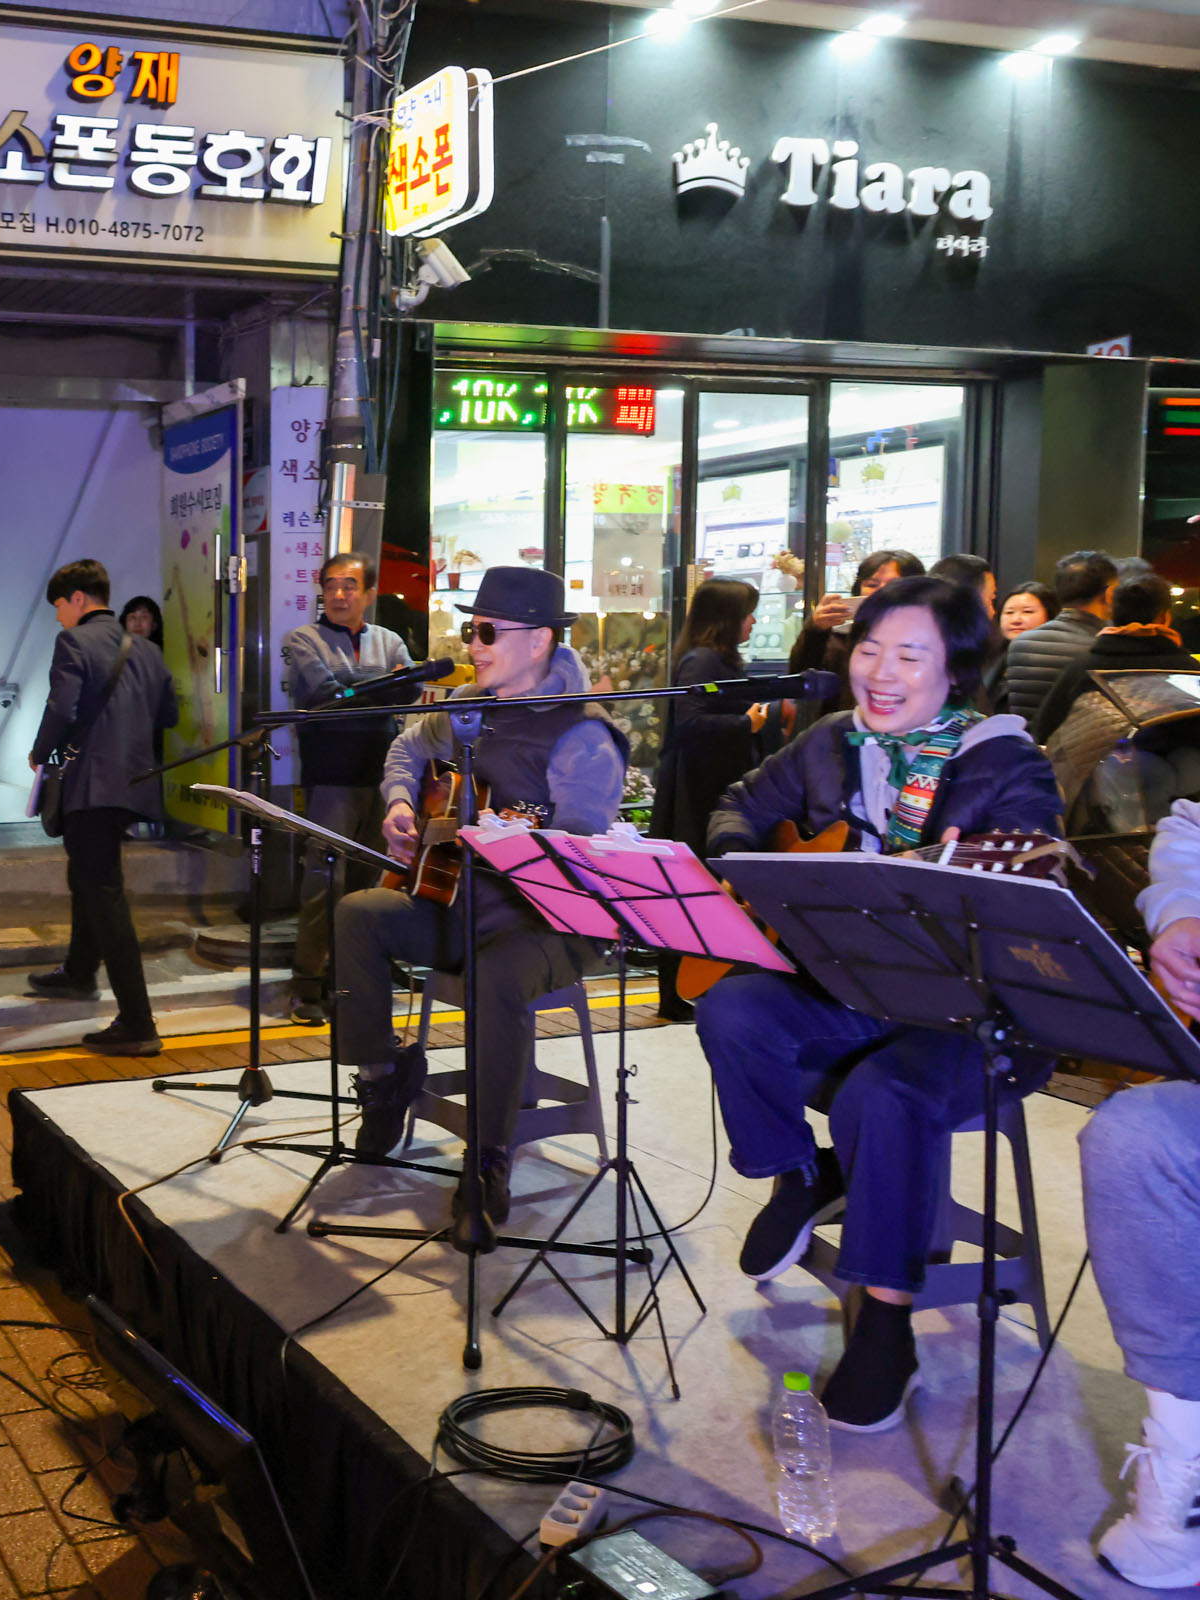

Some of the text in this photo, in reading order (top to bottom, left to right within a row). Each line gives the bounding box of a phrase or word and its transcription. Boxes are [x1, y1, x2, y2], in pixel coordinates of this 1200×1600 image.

[67, 42, 182, 106] 양재
[771, 136, 994, 221] Tiara
[45, 218, 205, 243] H.010-4875-7072
